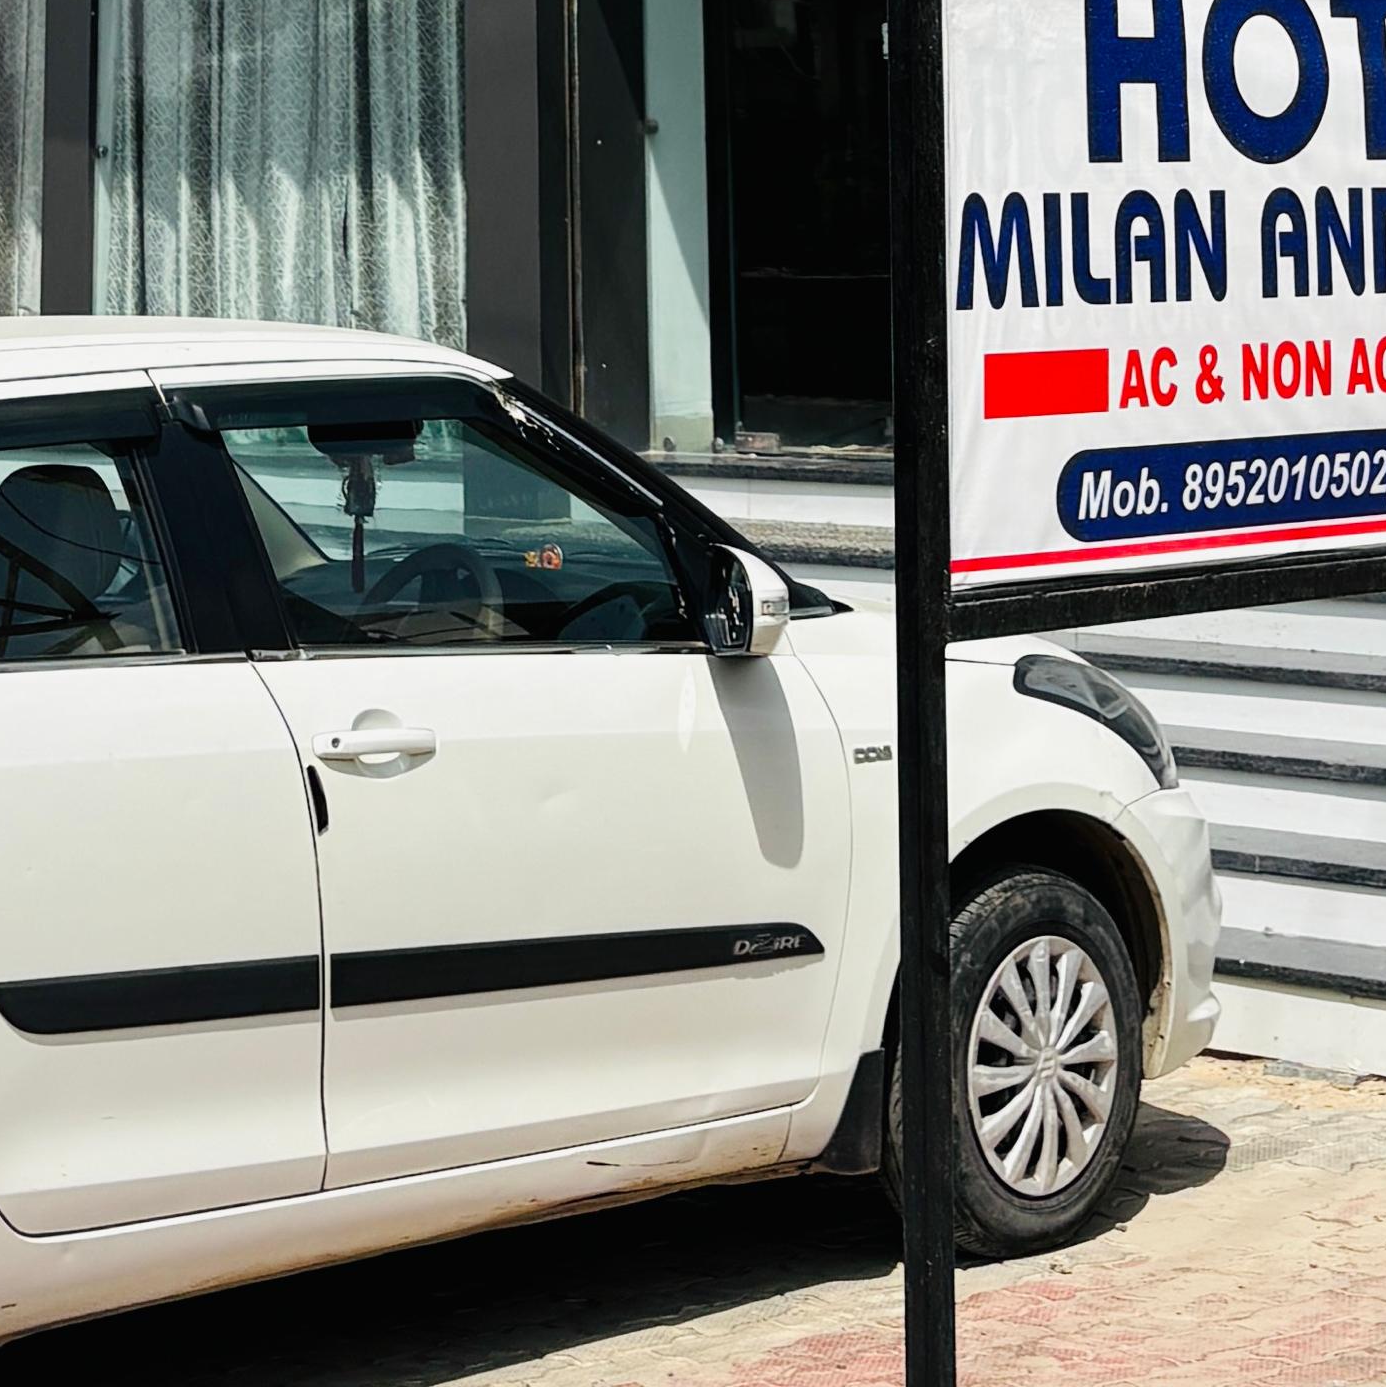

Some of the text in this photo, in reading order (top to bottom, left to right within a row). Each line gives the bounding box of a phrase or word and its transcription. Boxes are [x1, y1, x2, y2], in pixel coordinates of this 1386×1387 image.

[954, 188, 1228, 311] MILAN
[1119, 345, 1178, 410] AC
[1195, 343, 1225, 403] &
[1241, 339, 1333, 400] NON
[1077, 469, 1169, 521] Mob.
